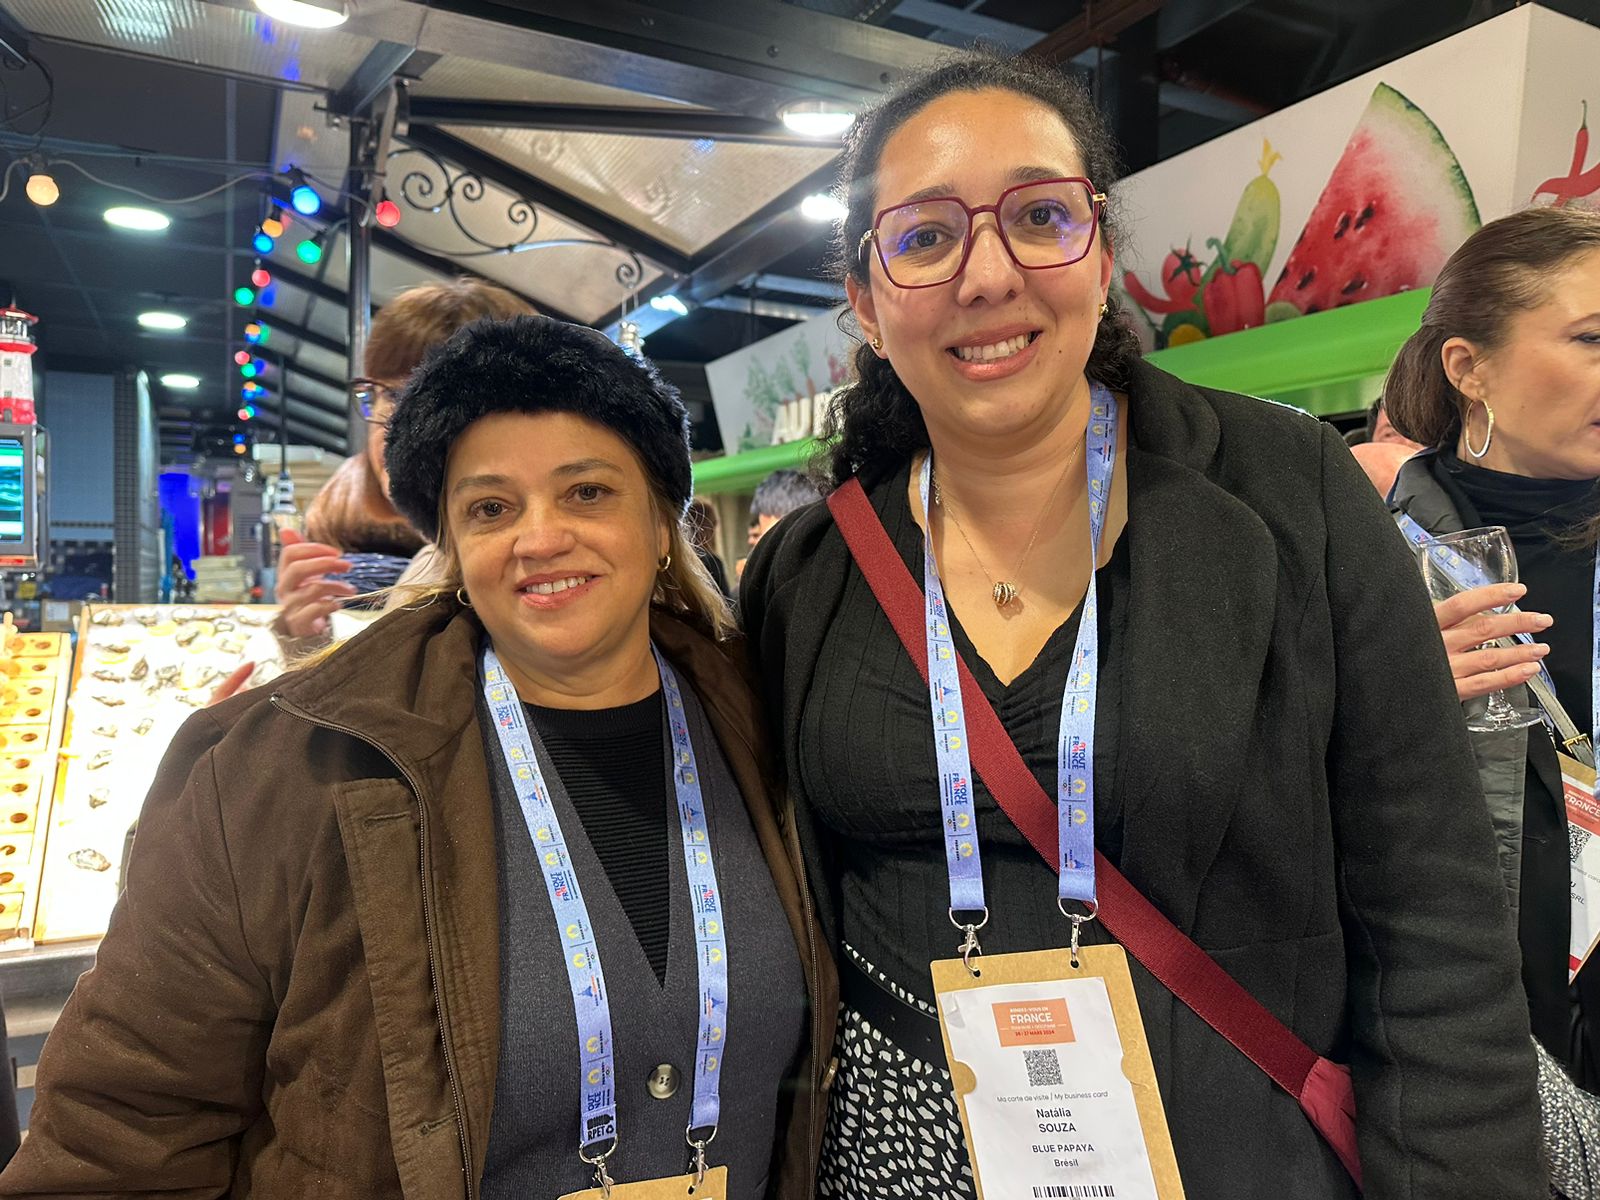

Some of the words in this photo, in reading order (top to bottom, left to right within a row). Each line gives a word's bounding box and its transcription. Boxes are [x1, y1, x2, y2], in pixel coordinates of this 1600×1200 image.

[1072, 736, 1080, 770] FRANCE
[1078, 742, 1086, 770] ATOUT
[952, 773, 962, 805] FRANCE
[959, 778, 968, 804] ATOUT
[1564, 793, 1600, 817] FRANCE
[550, 873, 562, 897] ATOUT
[556, 871, 570, 901] FRANCE
[1010, 1012, 1053, 1024] FRANCE
[1033, 1093, 1049, 1101] visite
[1054, 1093, 1064, 1101] My
[1065, 1092, 1092, 1100] business
[1093, 1090, 1108, 1098] card
[1036, 1107, 1072, 1118] Natália
[587, 1126, 605, 1141] RPET
[1038, 1122, 1077, 1133] SOUZA
[1032, 1144, 1056, 1153] BLUE
[1057, 1143, 1095, 1152] PAPAYA
[1053, 1158, 1079, 1167] Brésil
